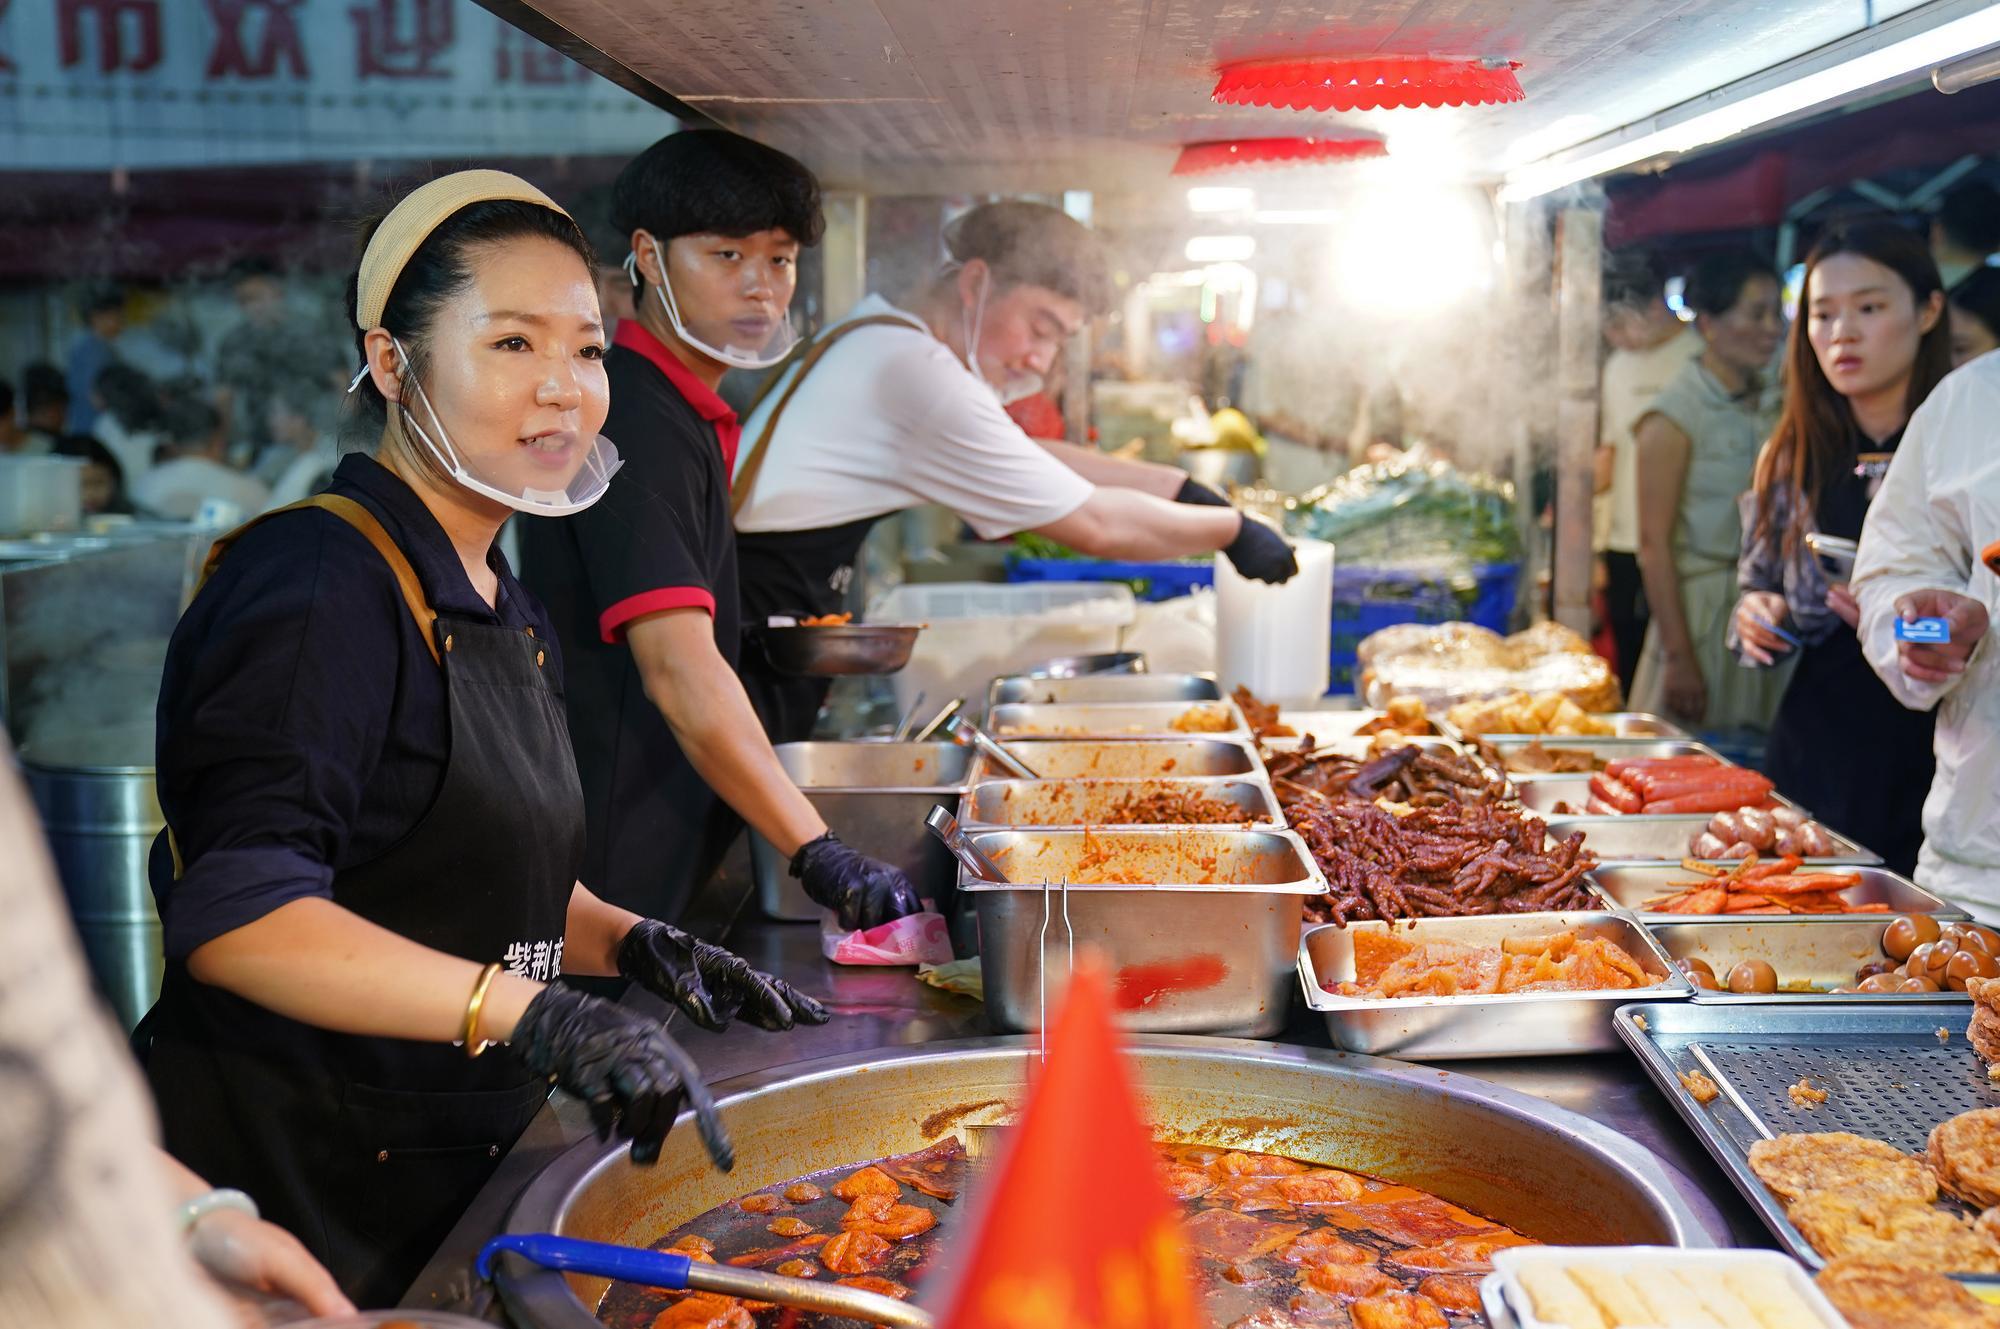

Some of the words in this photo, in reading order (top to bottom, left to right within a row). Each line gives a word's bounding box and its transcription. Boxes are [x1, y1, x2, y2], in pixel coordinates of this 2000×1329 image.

[0, 0, 593, 84] 市欢迎
[1902, 620, 1941, 639] 15
